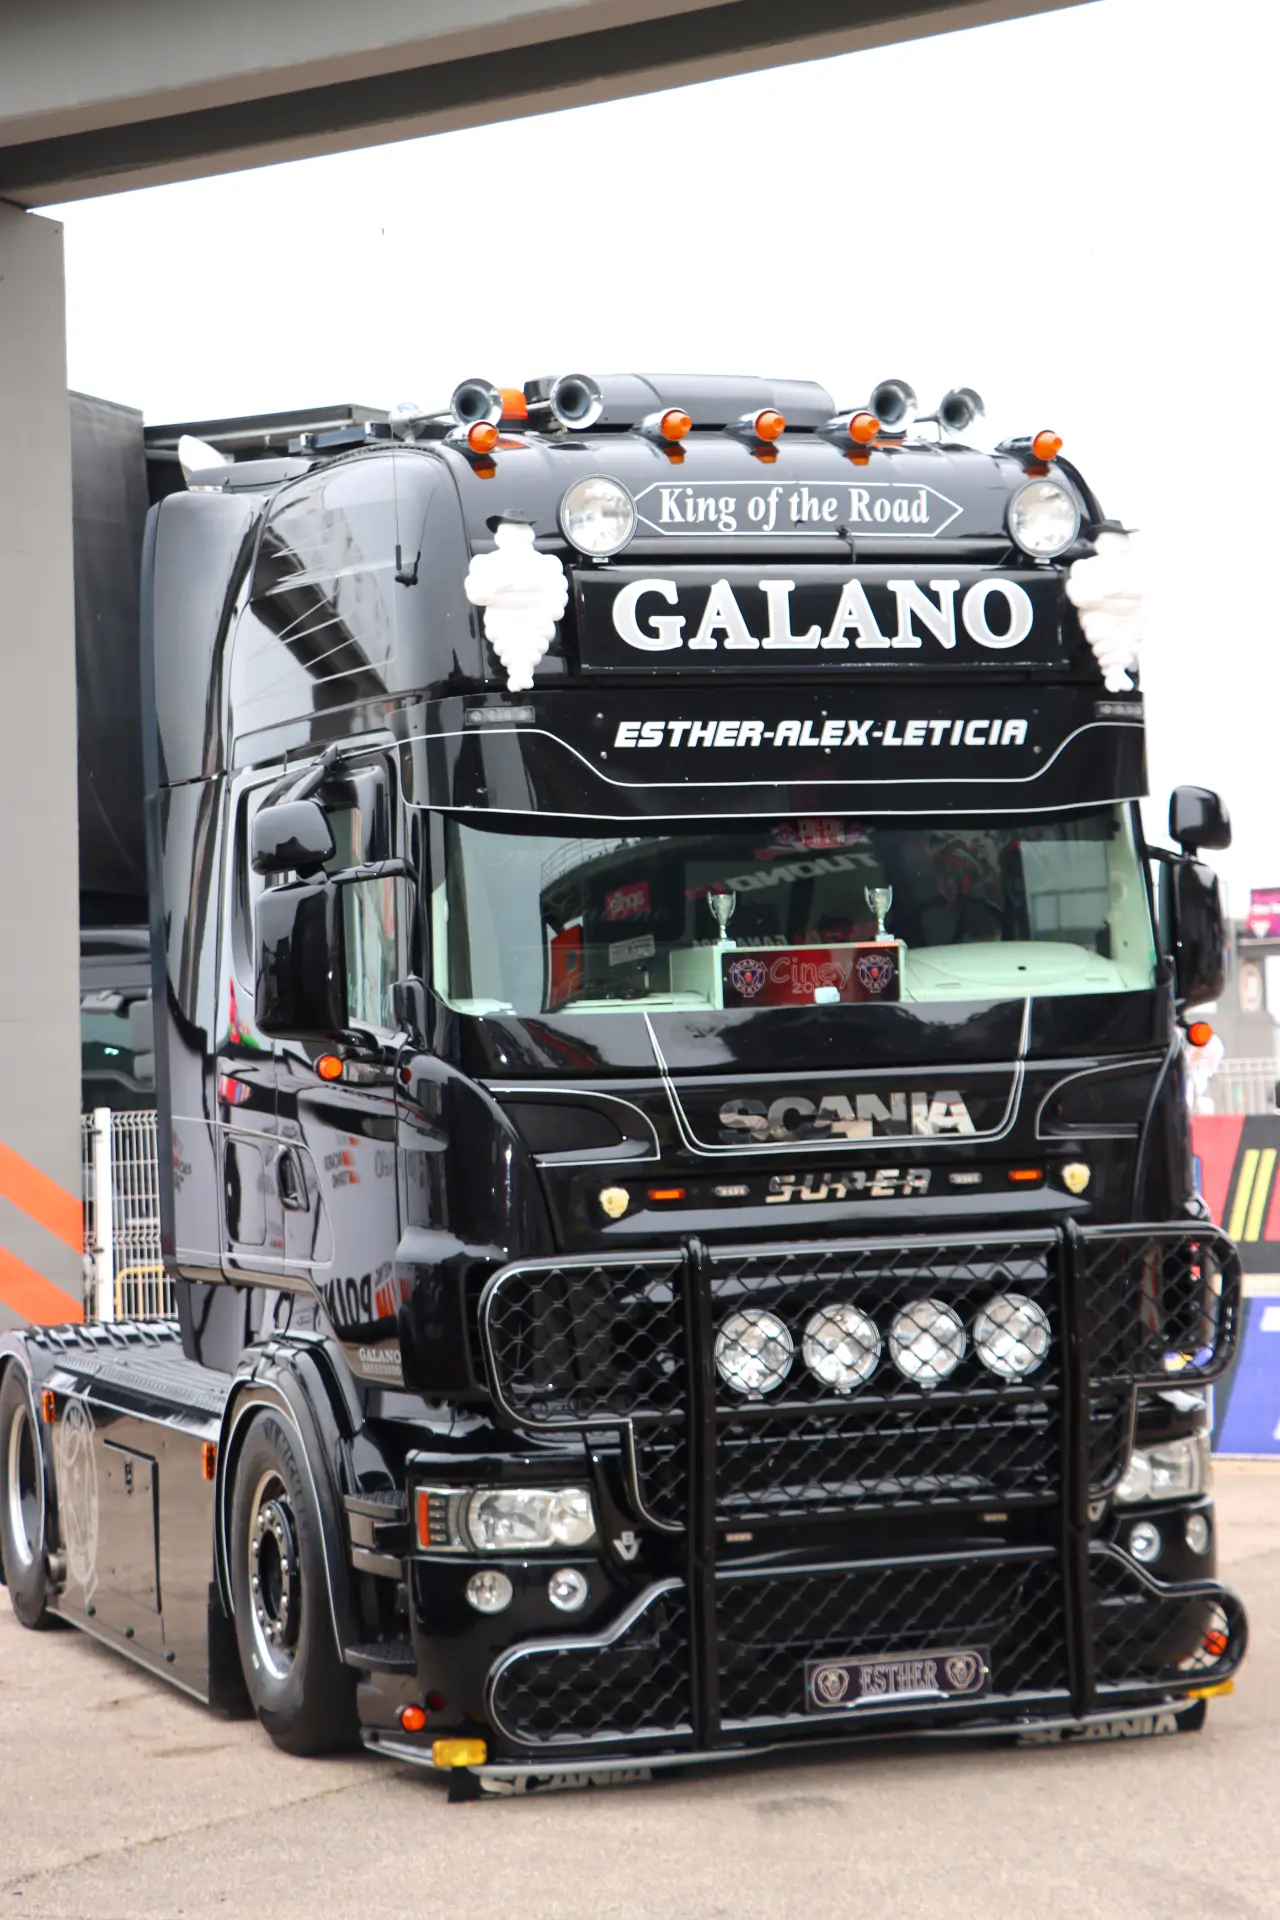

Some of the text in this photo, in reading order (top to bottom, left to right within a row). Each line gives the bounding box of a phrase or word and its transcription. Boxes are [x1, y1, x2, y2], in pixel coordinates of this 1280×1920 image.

[658, 487, 931, 532] King of the Road
[612, 578, 1034, 651] GALANO
[613, 719, 1029, 748] ESTHER-ALEX-LETICIA
[769, 956, 854, 990] Ciney
[718, 1090, 977, 1145] SCANIA
[765, 1168, 932, 1204] SUPER
[359, 1347, 402, 1364] GALANO
[858, 1659, 940, 1695] ESTHER
